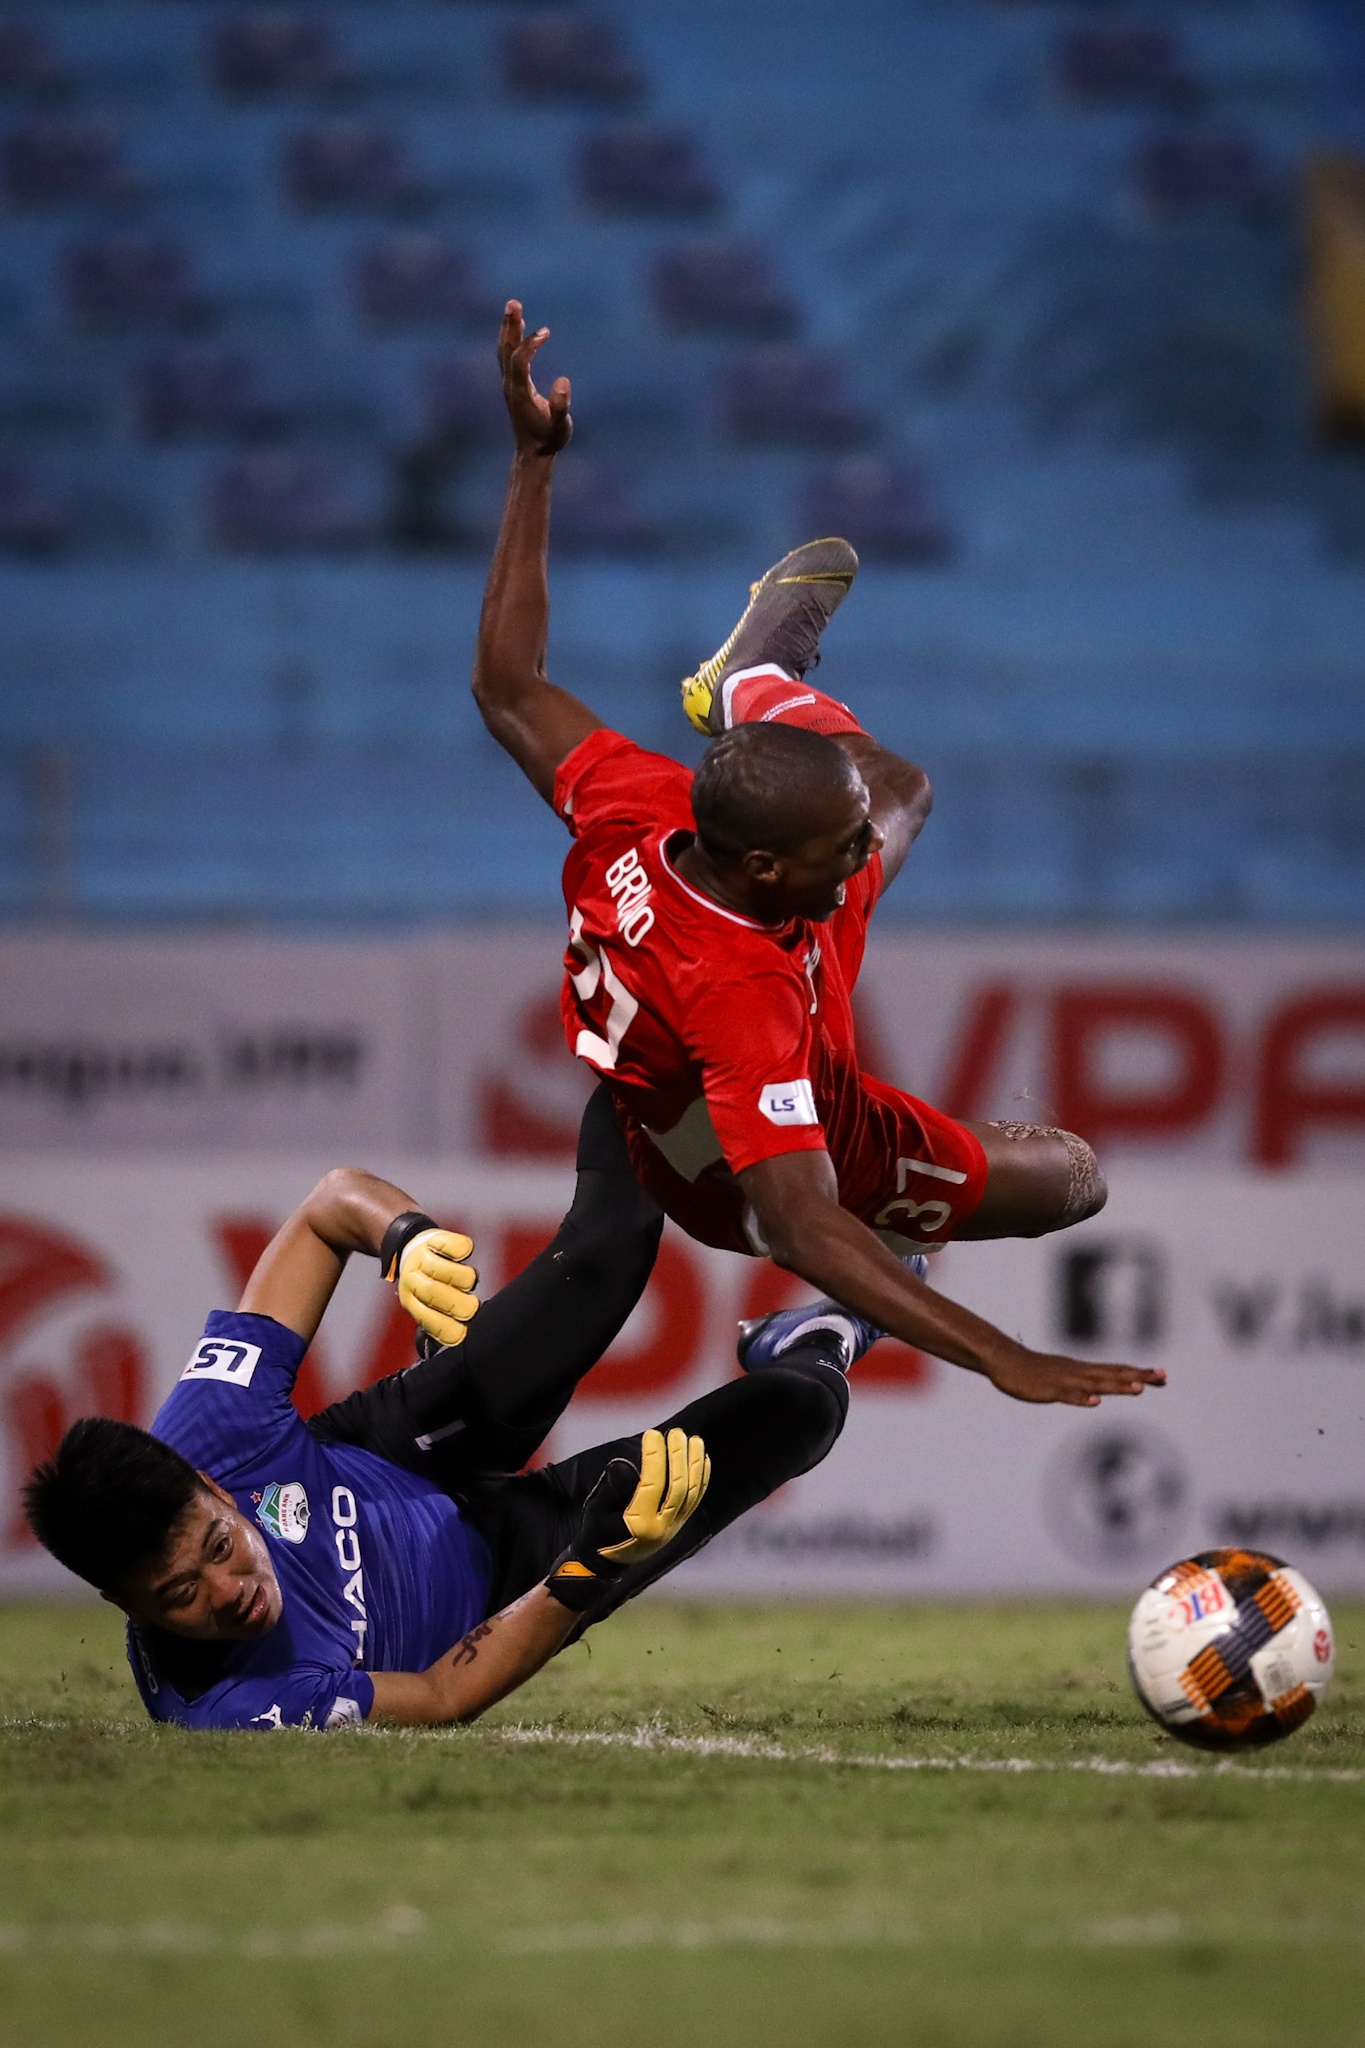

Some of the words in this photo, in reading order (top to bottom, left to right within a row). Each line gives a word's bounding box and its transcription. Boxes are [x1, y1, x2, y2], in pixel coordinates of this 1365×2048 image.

[770, 1098, 796, 1112] LS
[874, 1156, 968, 1232] 37
[193, 1343, 248, 1373] LS
